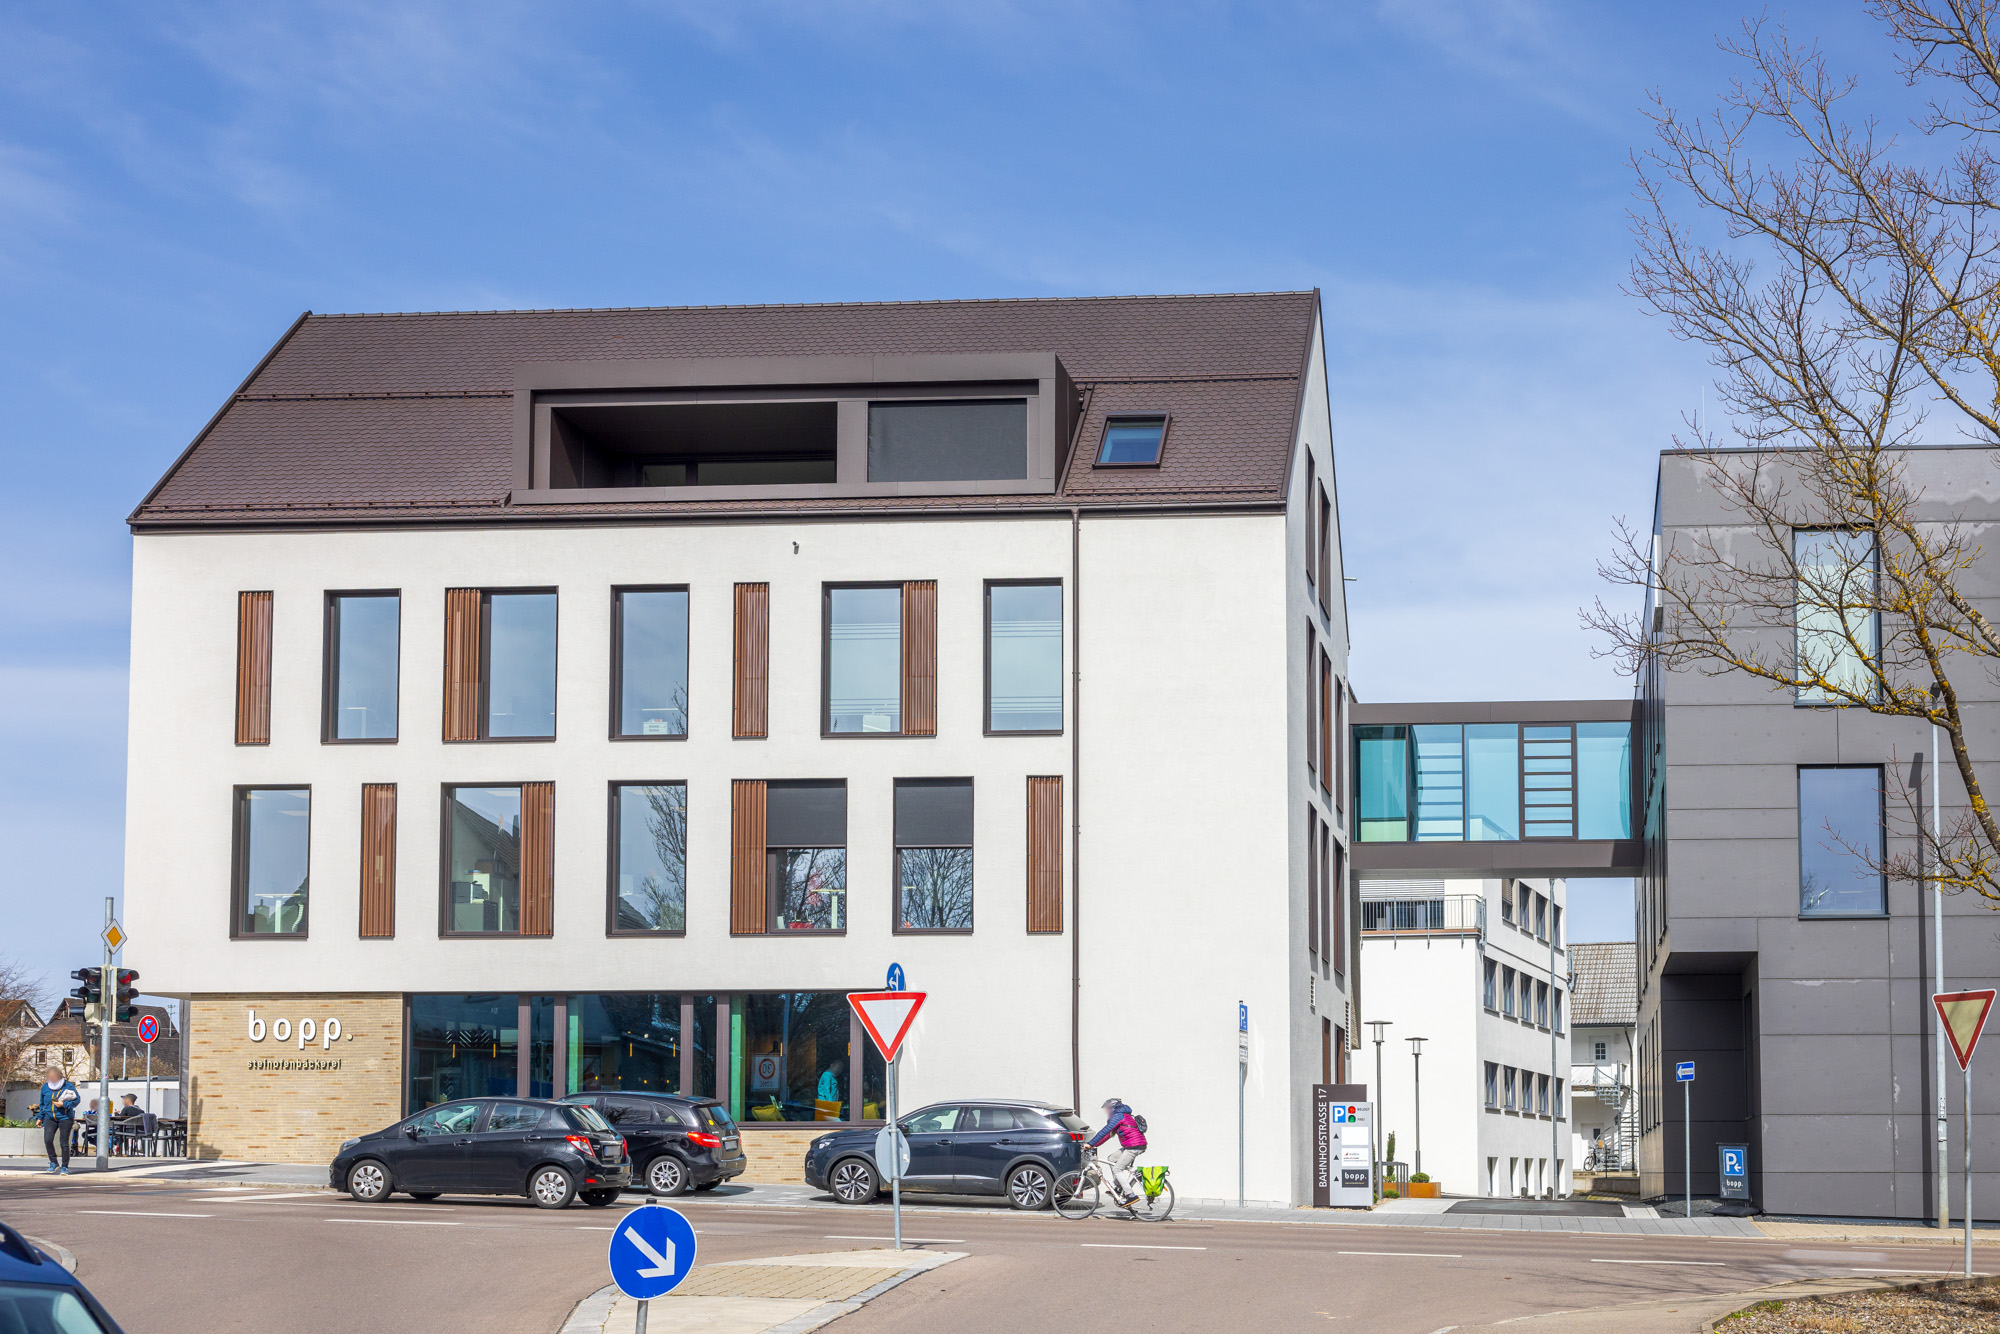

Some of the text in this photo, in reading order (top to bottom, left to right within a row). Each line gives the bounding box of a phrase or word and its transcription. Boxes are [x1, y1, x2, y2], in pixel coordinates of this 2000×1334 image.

[1240, 1007, 1246, 1027] P
[248, 1010, 353, 1050] bopp.
[247, 1059, 342, 1070] steinofenbäckerei
[1334, 1107, 1345, 1122] P
[1318, 1088, 1328, 1188] BAHNHOFSTRASSE 17
[1725, 1152, 1737, 1172] P
[1344, 1172, 1367, 1181] bopp.
[1726, 1179, 1744, 1188] bopp.
